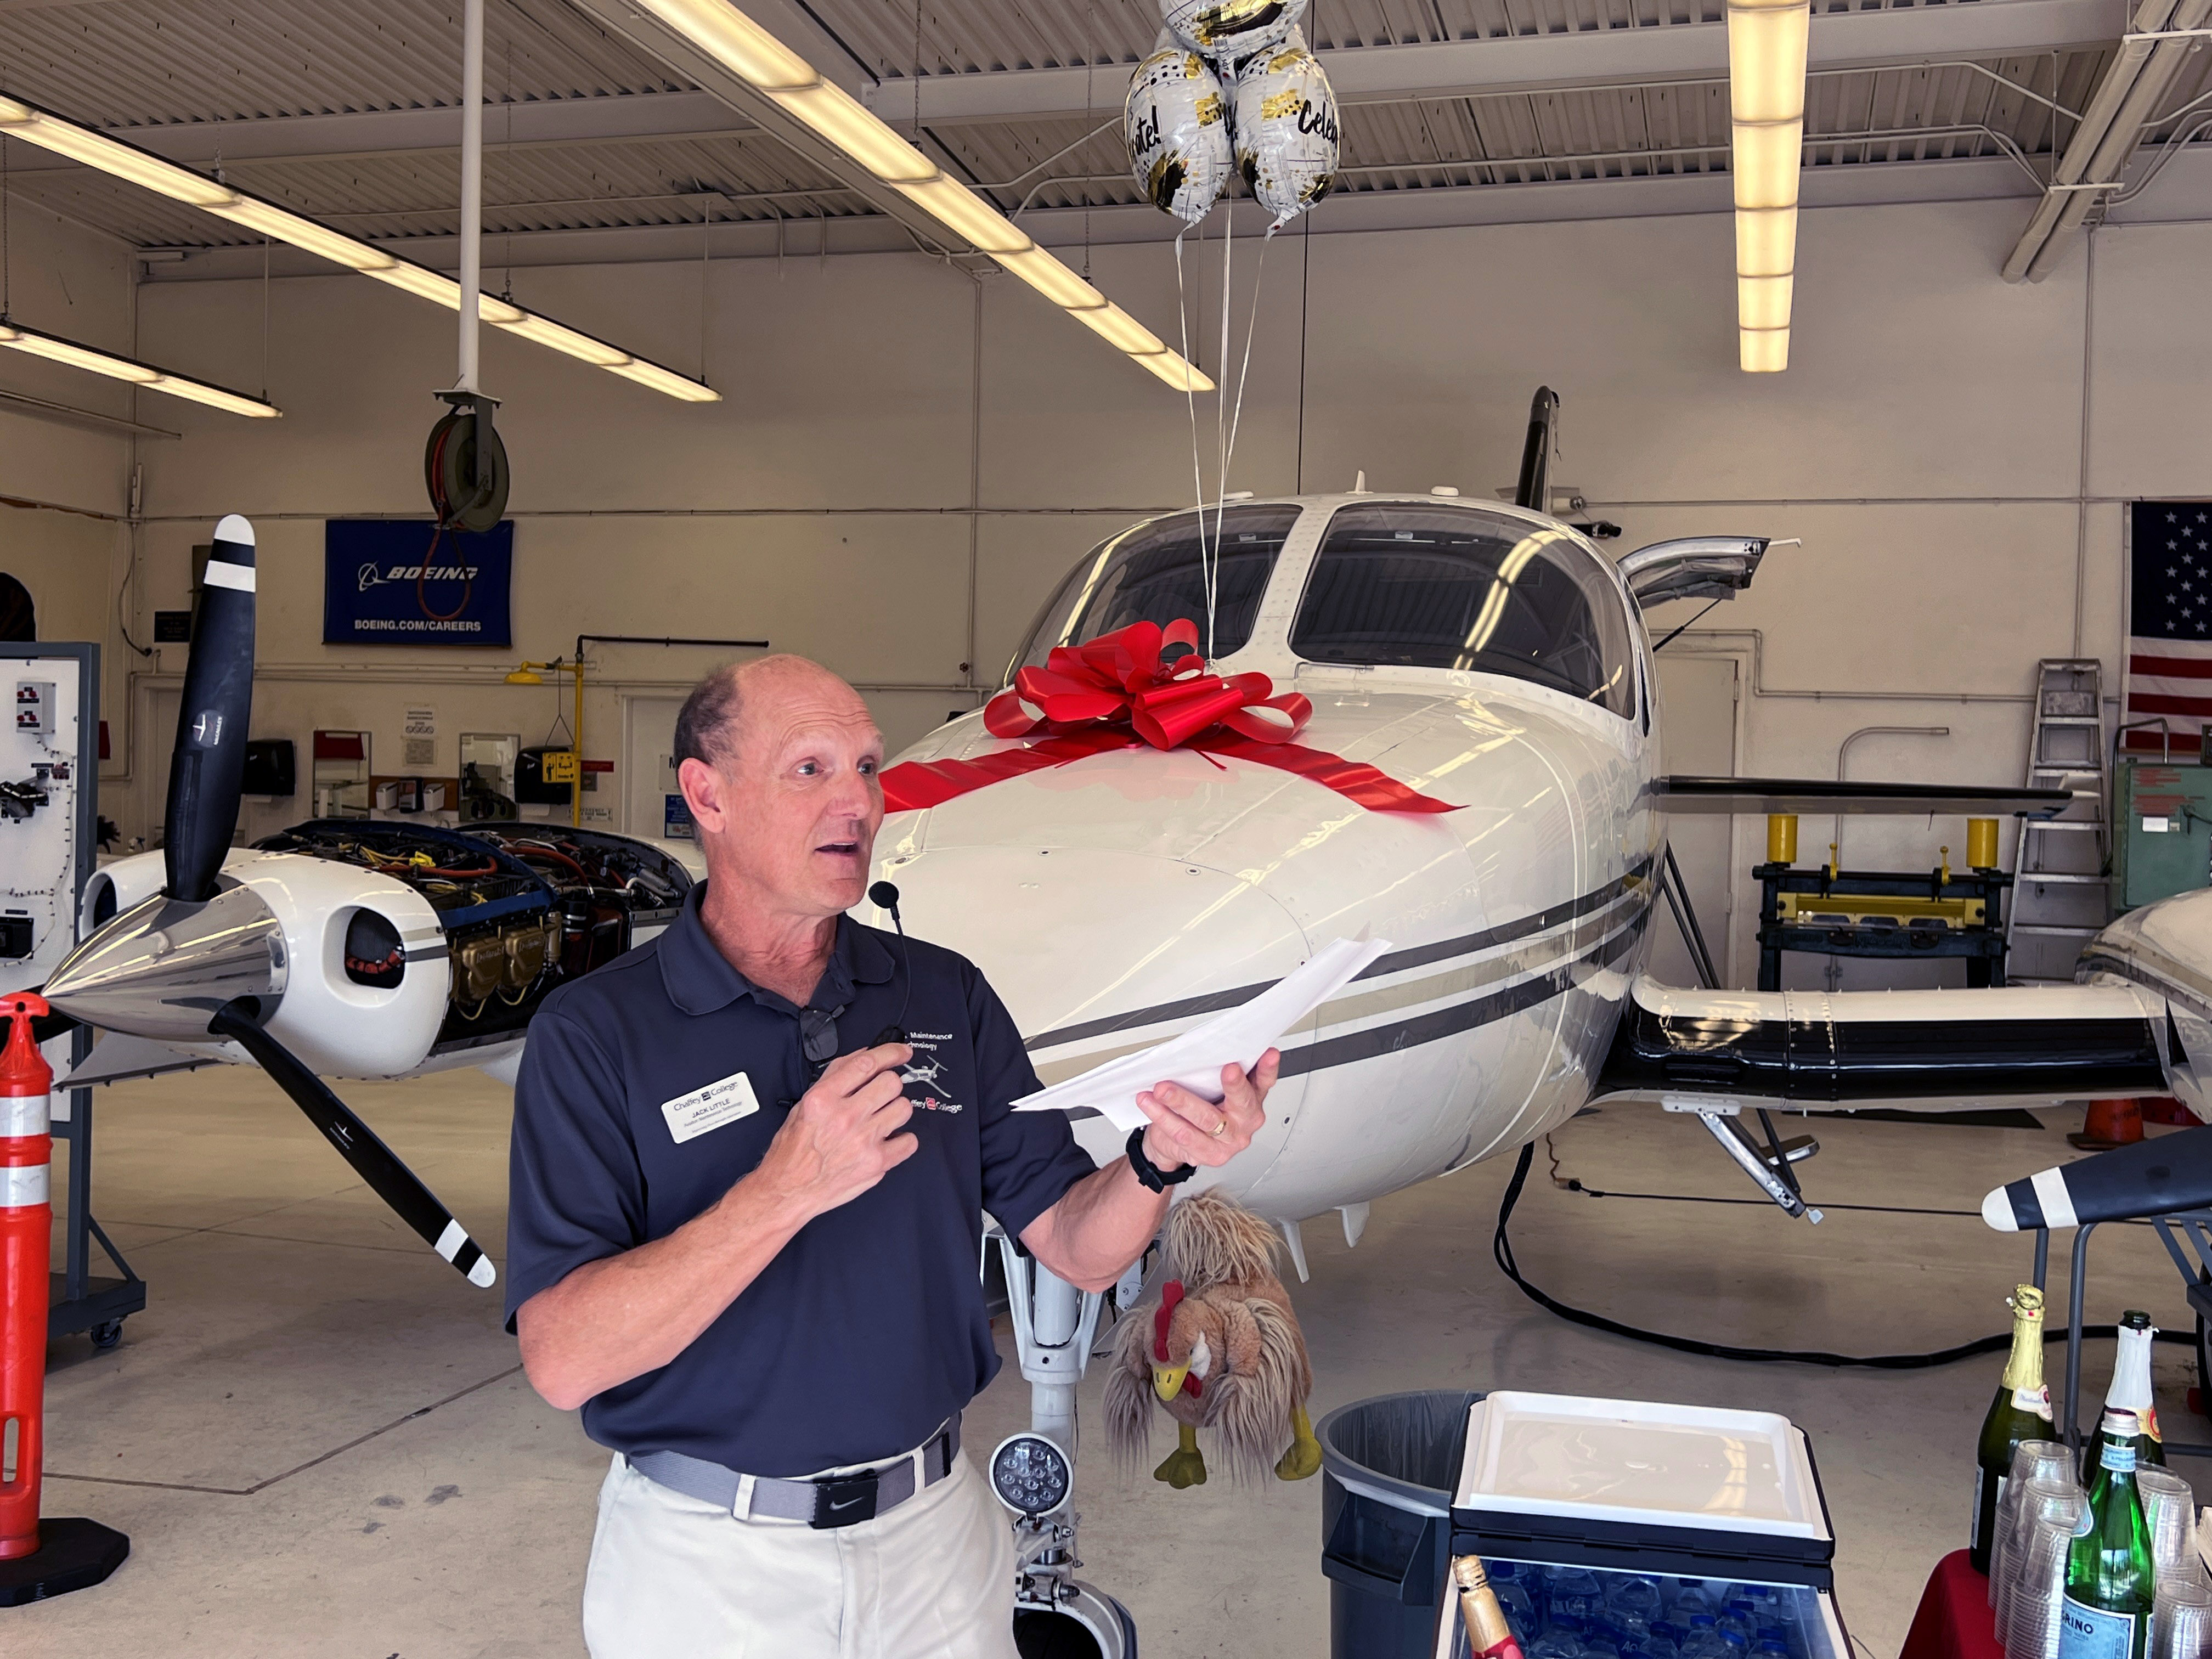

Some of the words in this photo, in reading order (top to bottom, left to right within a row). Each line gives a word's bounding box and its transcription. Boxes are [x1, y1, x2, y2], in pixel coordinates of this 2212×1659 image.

[354, 619, 482, 632] BOEING.COM/CAREERS
[910, 1031, 952, 1040] Maintenance
[907, 1041, 938, 1051] chnology
[674, 1096, 702, 1111] Chaffey
[711, 1082, 738, 1096] College
[692, 1107, 709, 1118] JACK
[709, 1098, 730, 1110] LITTLE
[911, 1099, 926, 1109] ffey
